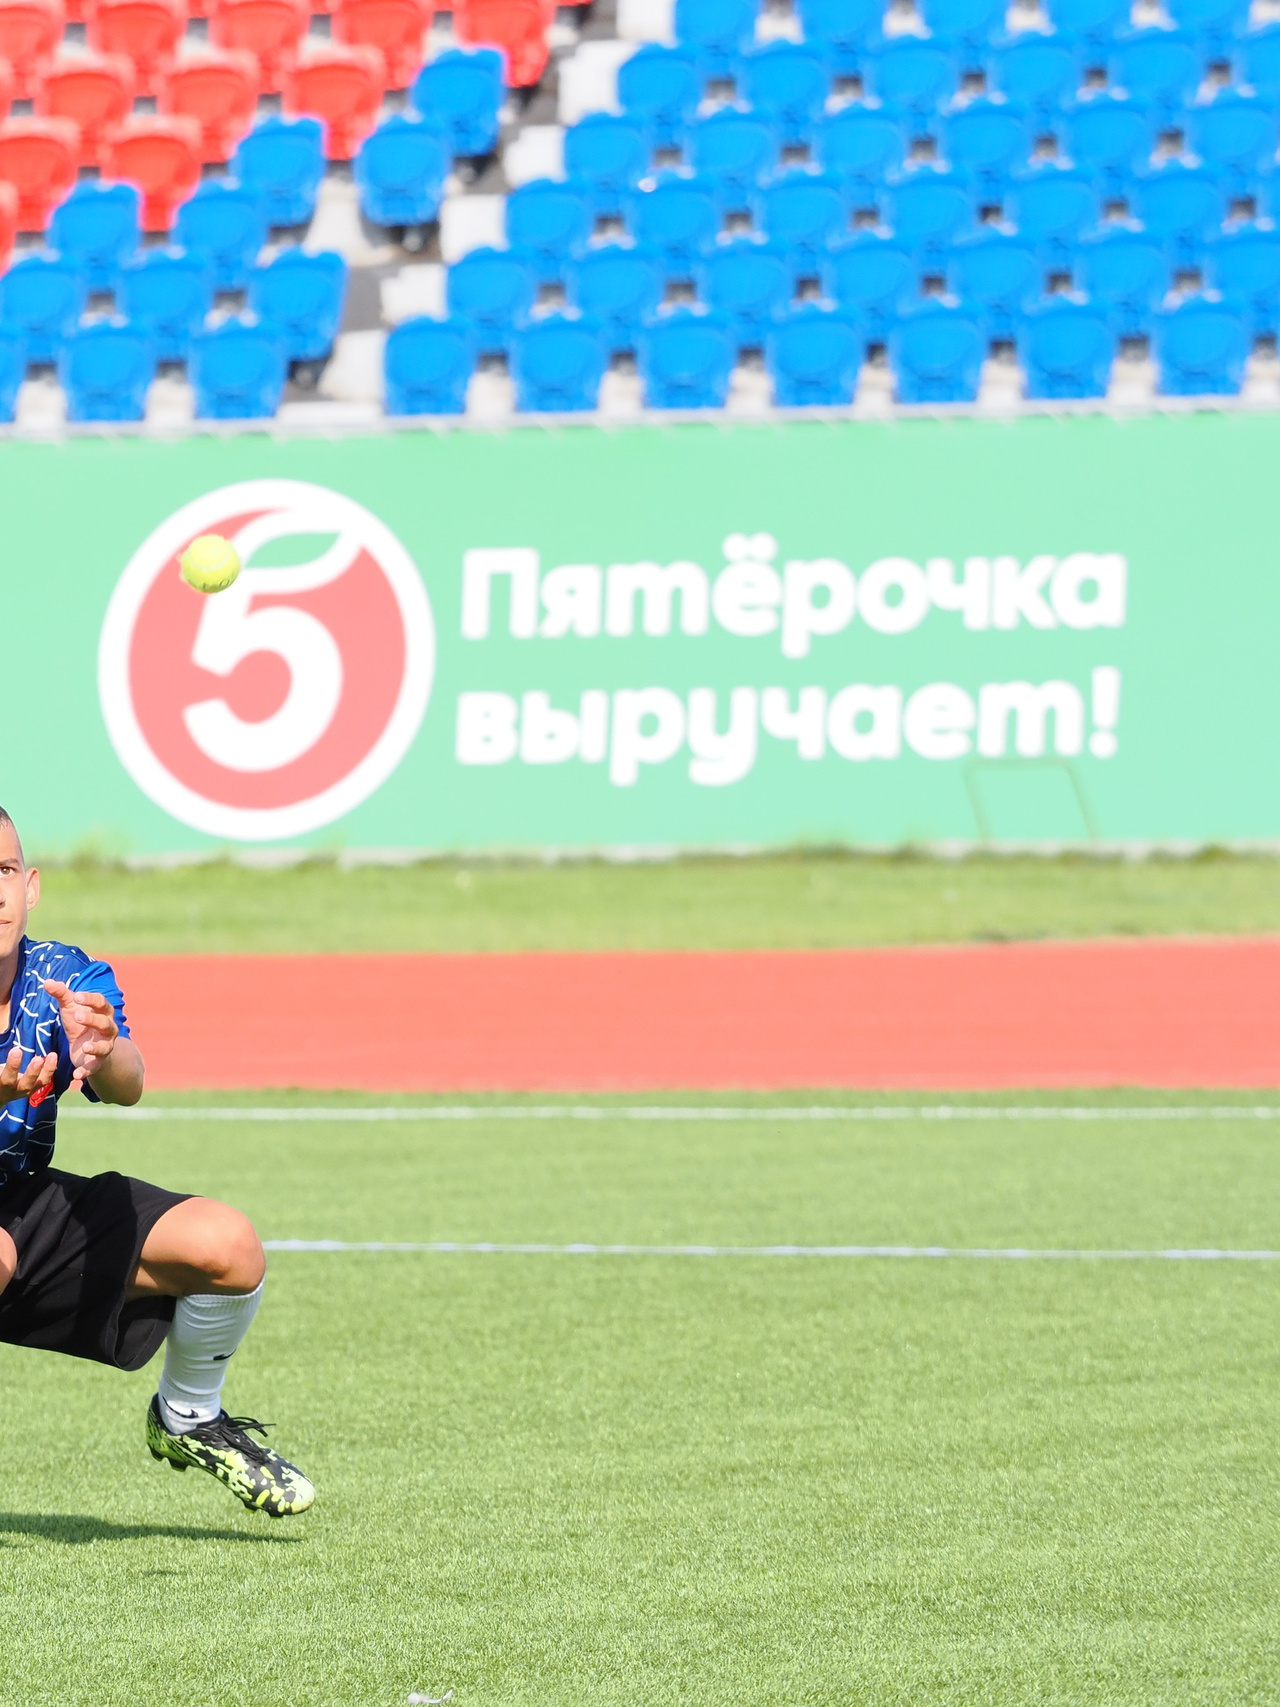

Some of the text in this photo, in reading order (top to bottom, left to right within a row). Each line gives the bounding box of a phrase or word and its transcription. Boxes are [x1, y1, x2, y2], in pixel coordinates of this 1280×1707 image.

[460, 532, 1127, 659] Пятёрочка
[181, 562, 345, 772] 5
[455, 666, 1121, 787] выручает!
